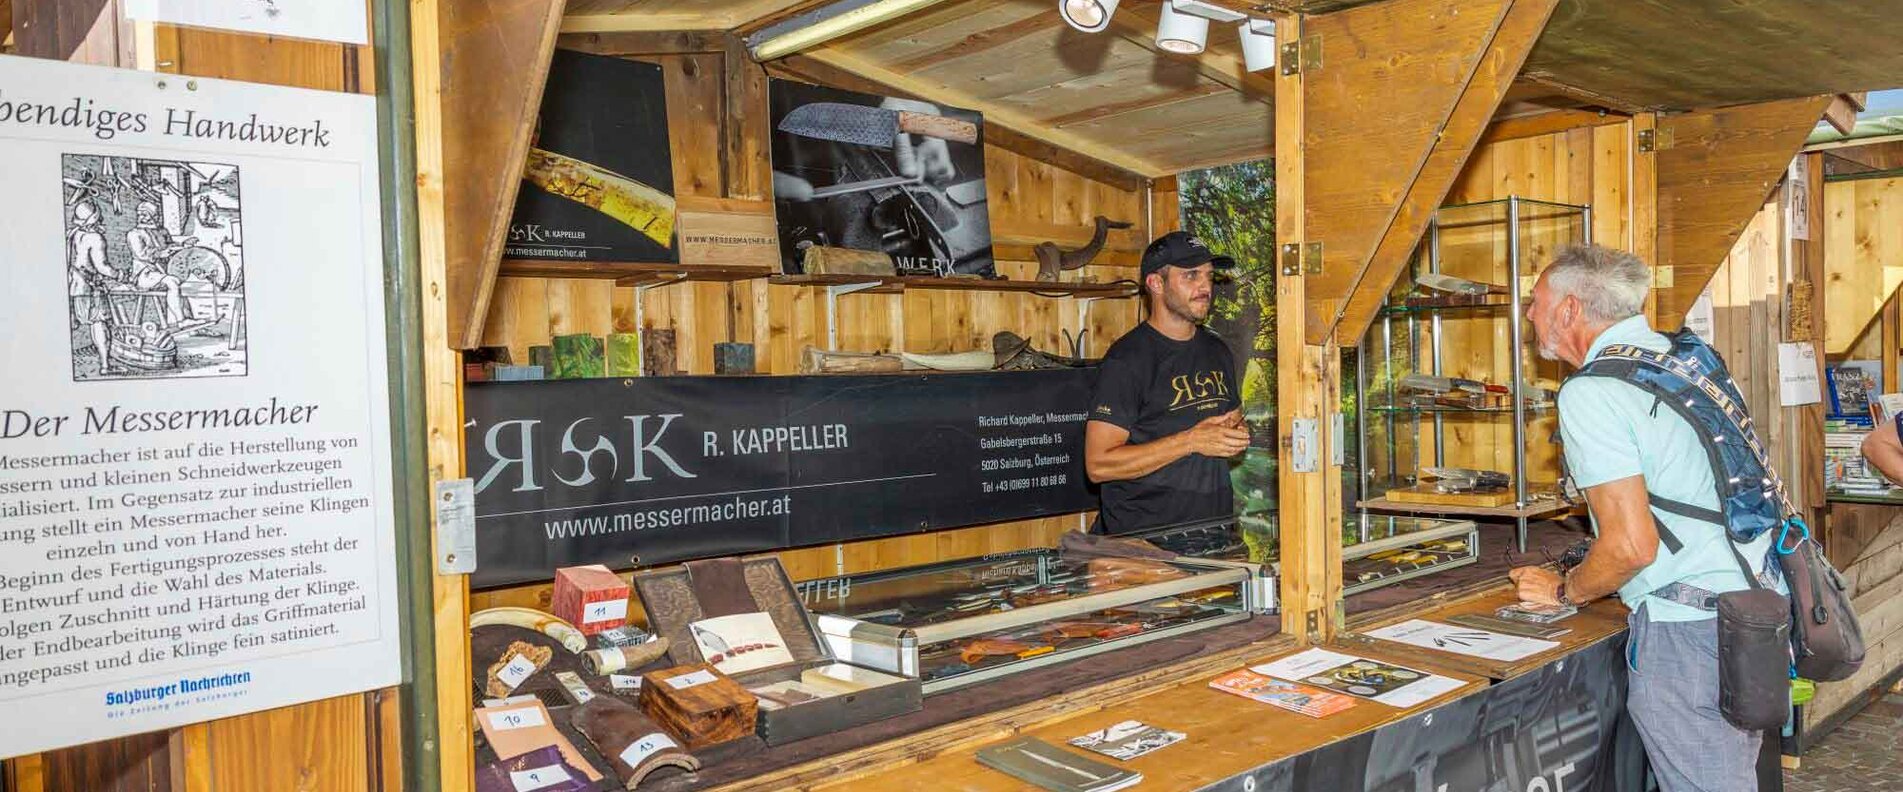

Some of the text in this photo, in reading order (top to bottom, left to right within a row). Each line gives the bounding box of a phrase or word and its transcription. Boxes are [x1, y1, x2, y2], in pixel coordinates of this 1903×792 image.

[163, 108, 332, 147] Handwerk
[552, 230, 586, 239] KAPPELLER
[0, 397, 318, 439] Der Messermacher
[979, 415, 1008, 427] Richard
[1009, 413, 1045, 427] Kappeller,
[138, 446, 158, 461] ist
[164, 443, 195, 460] auf
[198, 443, 224, 457] die
[231, 437, 326, 454] Herstellung
[331, 437, 358, 448] von
[703, 431, 724, 457] R.
[732, 424, 848, 455] KAPPELLER
[981, 433, 1062, 448] Gabelsbergerstraße 15
[60, 473, 97, 490] und
[104, 470, 171, 486] kleinen
[178, 459, 342, 481] Schneidwerkzeugen
[981, 454, 1070, 470] 5020 Salzburg, Österreich
[88, 496, 114, 510] Im
[121, 489, 213, 510] Gegensatz
[219, 486, 247, 500] zur
[253, 477, 352, 496] industriellen
[982, 481, 993, 493] Tel
[994, 480, 1008, 492] +43
[1031, 477, 1039, 487] 11
[42, 519, 87, 538] stellt
[94, 518, 122, 533] ein
[131, 505, 257, 530] Messermacher
[262, 502, 304, 517] seine
[310, 496, 369, 513] Klingen
[545, 495, 791, 539] www.messermacher.at
[46, 525, 288, 561] einzeln und von Hand her.
[71, 565, 103, 582] des
[110, 545, 286, 577] Fertigungsprozesses
[290, 540, 329, 557] steht
[333, 536, 358, 551] der
[2, 561, 327, 613] Entwurf und die Wahl des Materials.
[59, 605, 150, 629] Zuschnitt
[157, 598, 191, 617] und
[199, 591, 269, 612] Härtung
[274, 586, 300, 601] der
[306, 579, 360, 597] Klinge.
[594, 606, 606, 616] 11
[34, 627, 182, 657] Endbearbeitung
[187, 614, 225, 633] wird
[231, 612, 259, 628] das
[264, 595, 366, 623] Griffmaterial
[95, 651, 131, 670] und
[138, 648, 165, 664] die
[172, 640, 228, 659] Klinge
[234, 633, 265, 650] fein
[270, 622, 339, 644] satiniert.
[106, 671, 251, 705] Salzburger Nachrichten
[504, 715, 520, 726] 10
[530, 773, 540, 783] 9
